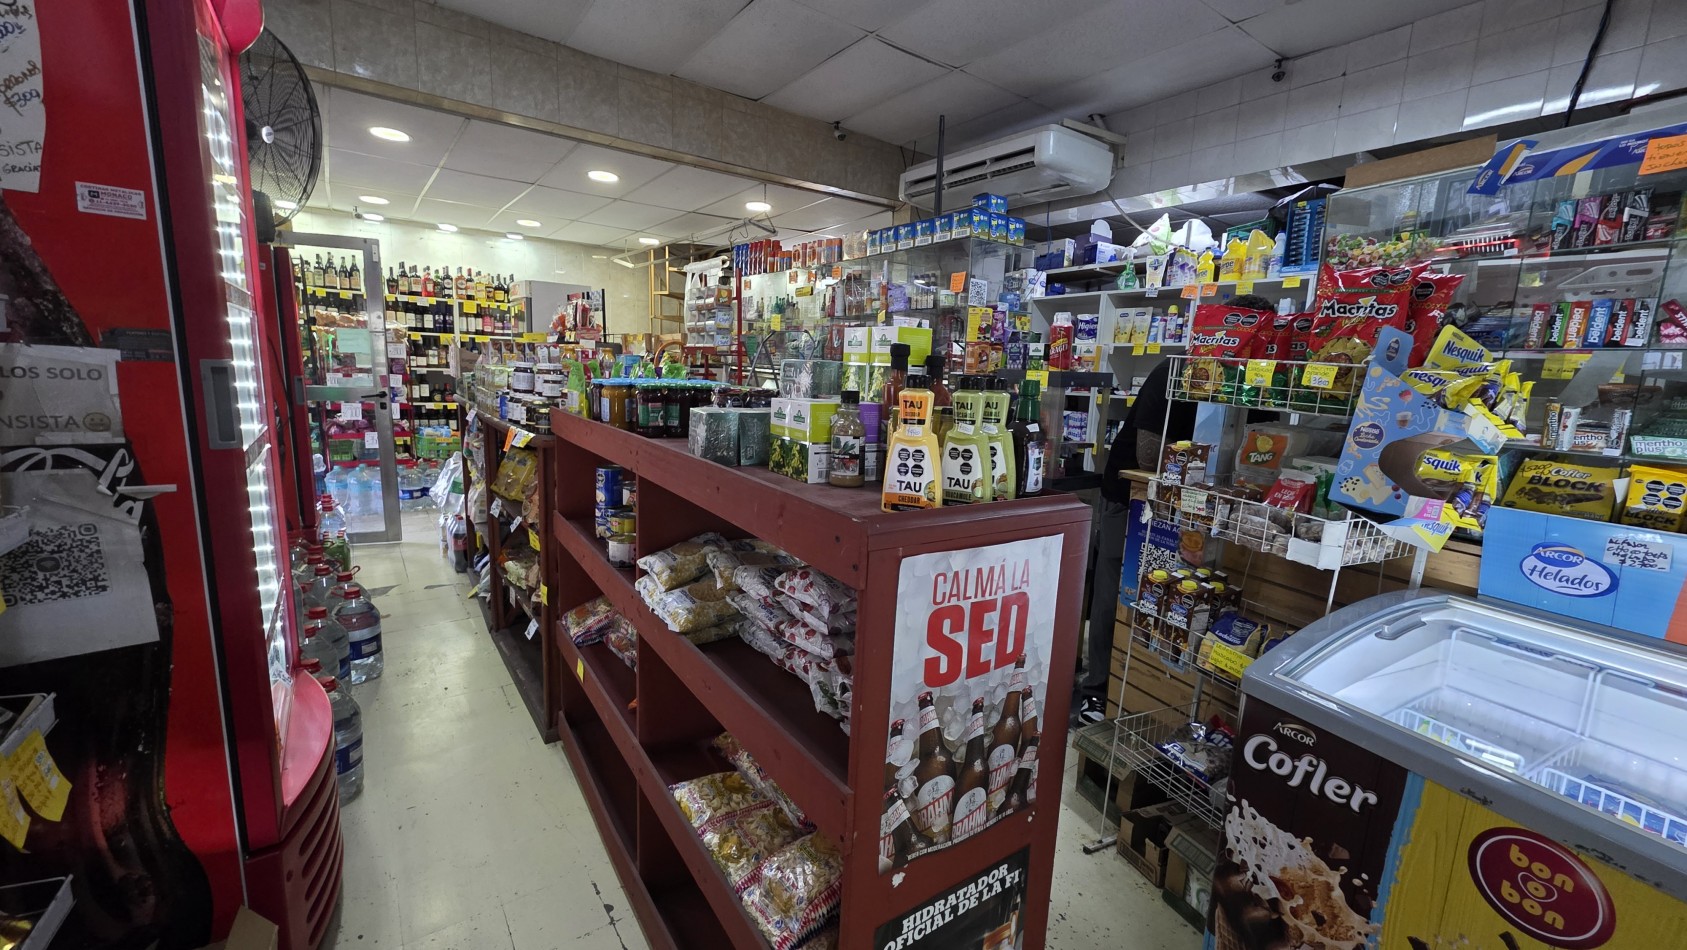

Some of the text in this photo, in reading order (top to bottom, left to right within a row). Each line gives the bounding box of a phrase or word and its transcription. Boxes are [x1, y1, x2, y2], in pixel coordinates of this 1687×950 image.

[1320, 299, 1397, 318] Macritas
[1529, 310, 1544, 341] beldent
[1550, 313, 1564, 342] beldent
[1568, 308, 1585, 341] beldent
[1588, 307, 1606, 343] beldent
[1611, 311, 1627, 341] beldent
[1636, 309, 1649, 339] beldent
[1191, 333, 1240, 346] Macritas
[1443, 340, 1484, 363] Nesquik
[46, 367, 102, 381] SOLO
[903, 400, 923, 409] TAU
[955, 402, 973, 410] TAU
[1574, 433, 1603, 441] entho
[1635, 440, 1683, 448] mentho
[1249, 452, 1273, 463] TANG
[1635, 445, 1662, 454] plus
[1423, 456, 1461, 471] squik
[1550, 467, 1592, 479] Cofler
[897, 480, 922, 492] TAU
[947, 477, 970, 490] TAU
[1527, 475, 1607, 493] BLOCK
[1533, 547, 1583, 564] ARCOR
[932, 558, 1030, 606] CALMÁ LA
[1528, 565, 1603, 591] Helados
[923, 591, 1030, 688] SED
[1273, 722, 1317, 747] ARCOR
[1243, 733, 1378, 813] Cofler
[1509, 843, 1575, 894] bon
[902, 863, 1009, 934] HIDRATADOR
[957, 894, 981, 917] DE
[982, 880, 1004, 905] LA
[1526, 880, 1548, 899] o
[1500, 879, 1566, 931] bon
